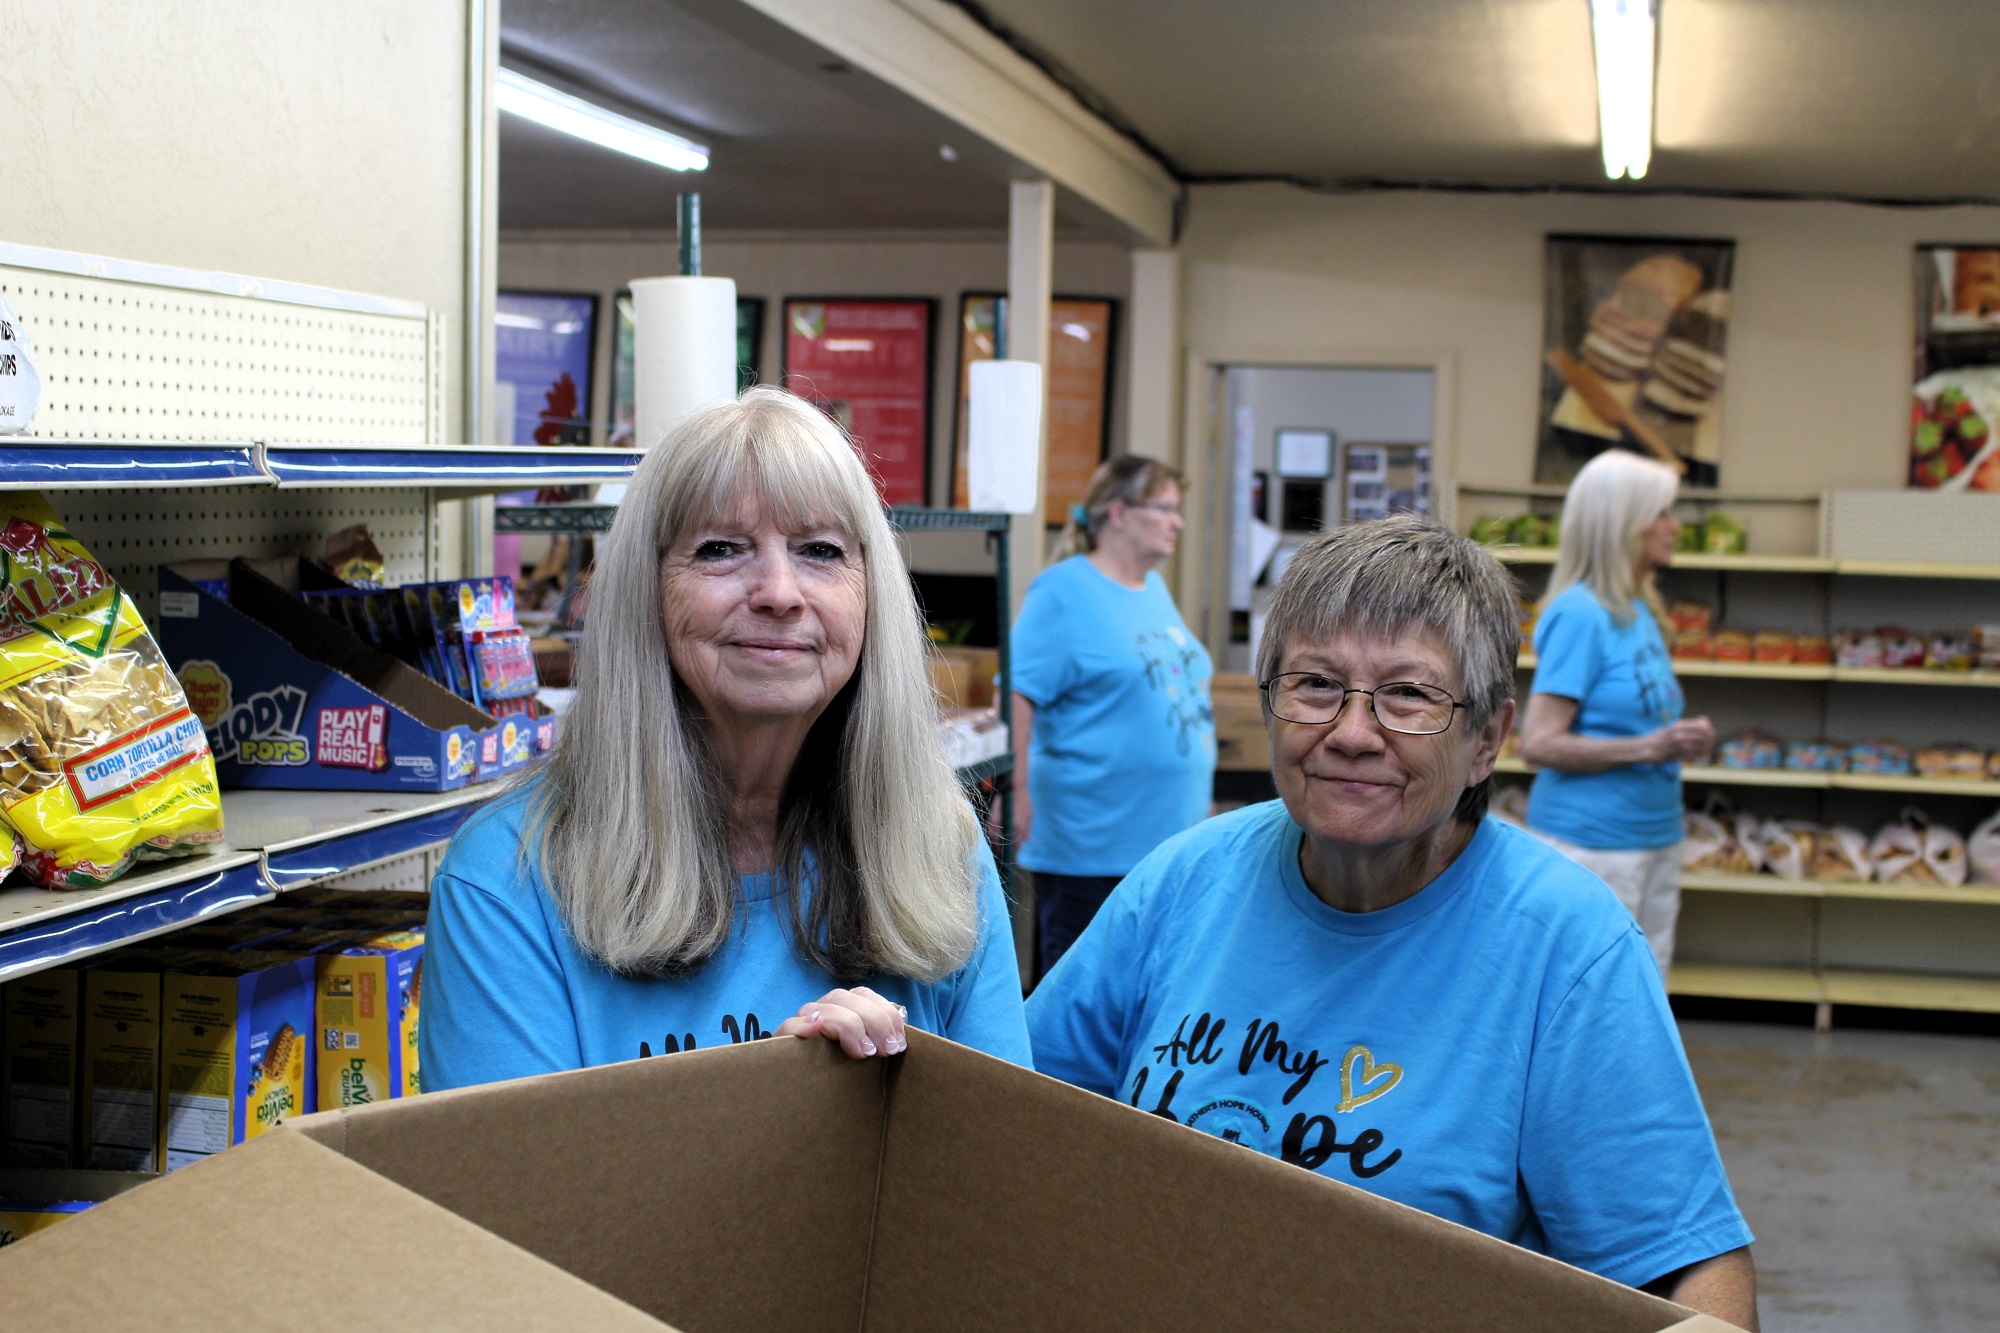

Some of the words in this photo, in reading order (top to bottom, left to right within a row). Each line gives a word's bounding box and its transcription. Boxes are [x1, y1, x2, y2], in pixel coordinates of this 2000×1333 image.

[58, 604, 97, 625] BRAND
[205, 686, 305, 758] ELODY
[320, 710, 369, 730] PLAY
[319, 728, 368, 749] REAL
[85, 754, 127, 782] CORN
[125, 731, 173, 766] TORTILLA
[175, 718, 202, 742] CHIP
[241, 741, 306, 761] POPS
[318, 747, 368, 765] MUSIC
[1154, 1012, 1226, 1068] All
[1238, 1018, 1329, 1105] My
[257, 1094, 294, 1126] belVita
[1219, 1099, 1246, 1111] HOPE
